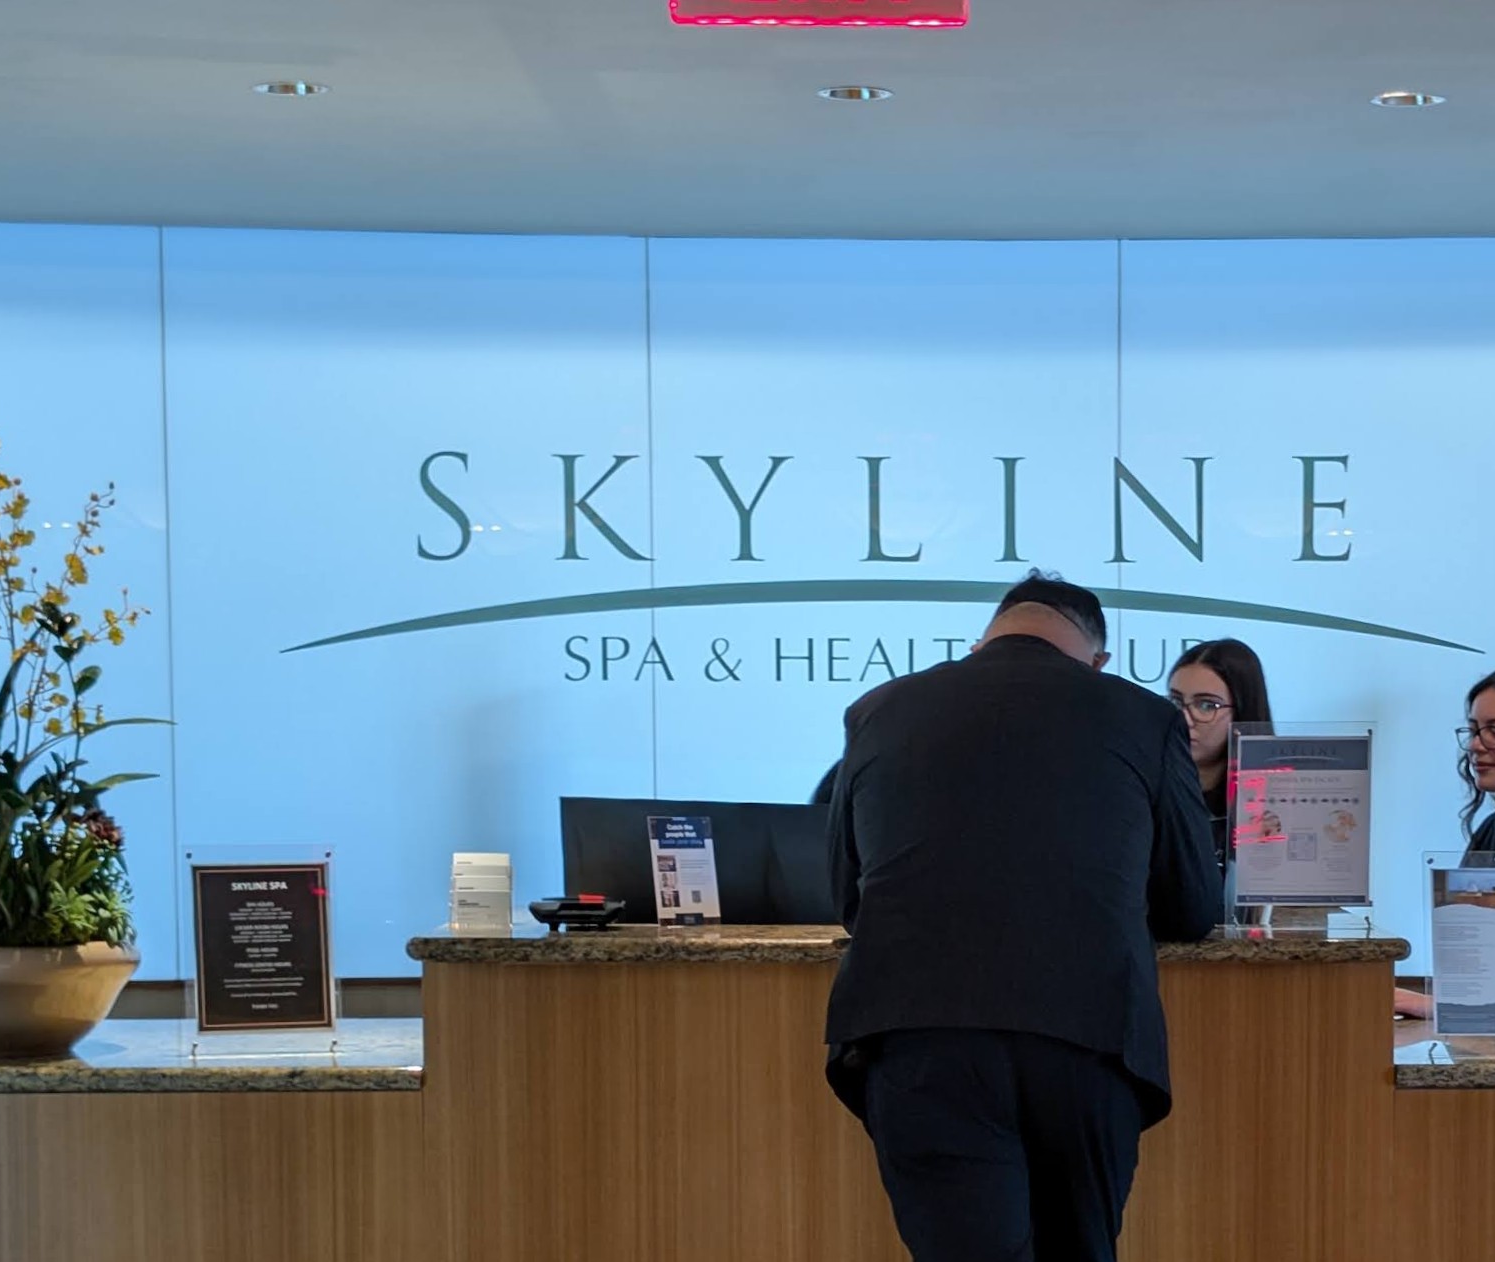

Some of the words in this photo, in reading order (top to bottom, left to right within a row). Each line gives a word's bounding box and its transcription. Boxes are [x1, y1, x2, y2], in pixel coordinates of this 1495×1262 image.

[416, 450, 1353, 563] SKYLINE
[563, 634, 675, 682] SPA
[704, 637, 743, 682] &
[774, 637, 985, 682] HEALT
[231, 881, 268, 891] SKYLINE
[269, 881, 288, 890] SPA
